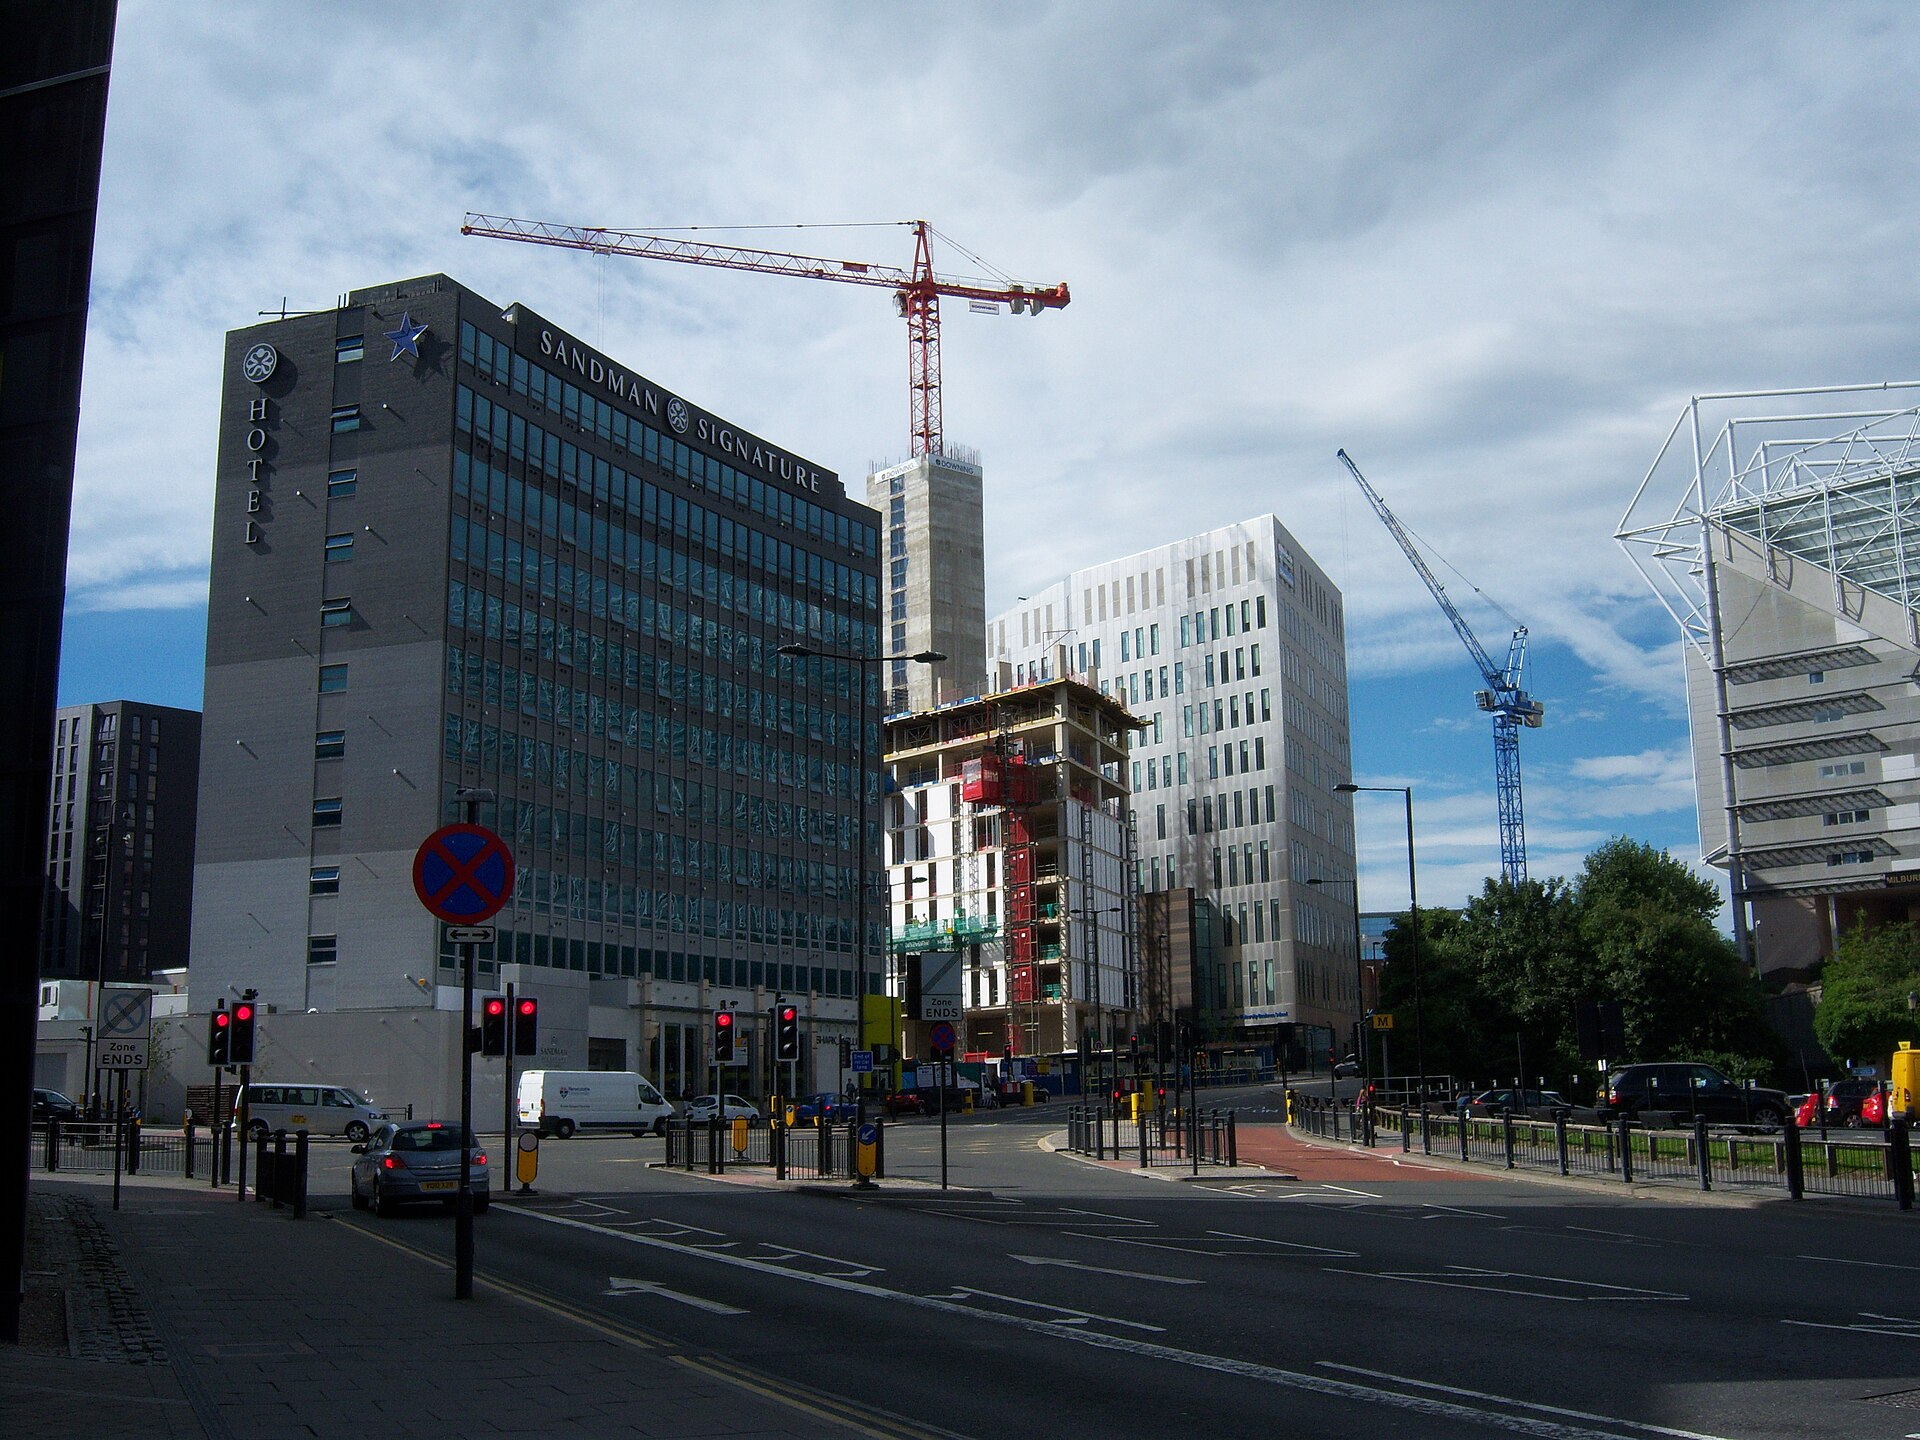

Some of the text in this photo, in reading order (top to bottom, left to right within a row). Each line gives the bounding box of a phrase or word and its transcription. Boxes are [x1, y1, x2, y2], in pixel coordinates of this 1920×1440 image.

[540, 329, 822, 494] SANDMAN SIGNATURE
[243, 398, 268, 545] HOTEL
[886, 462, 915, 480] DOWNING
[941, 460, 975, 476] DOWNING
[931, 998, 953, 1006] Zone
[925, 1008, 958, 1018] ENDS
[1377, 1016, 1389, 1027] M
[109, 1042, 136, 1051] Zone
[102, 1054, 143, 1065] ENDS
